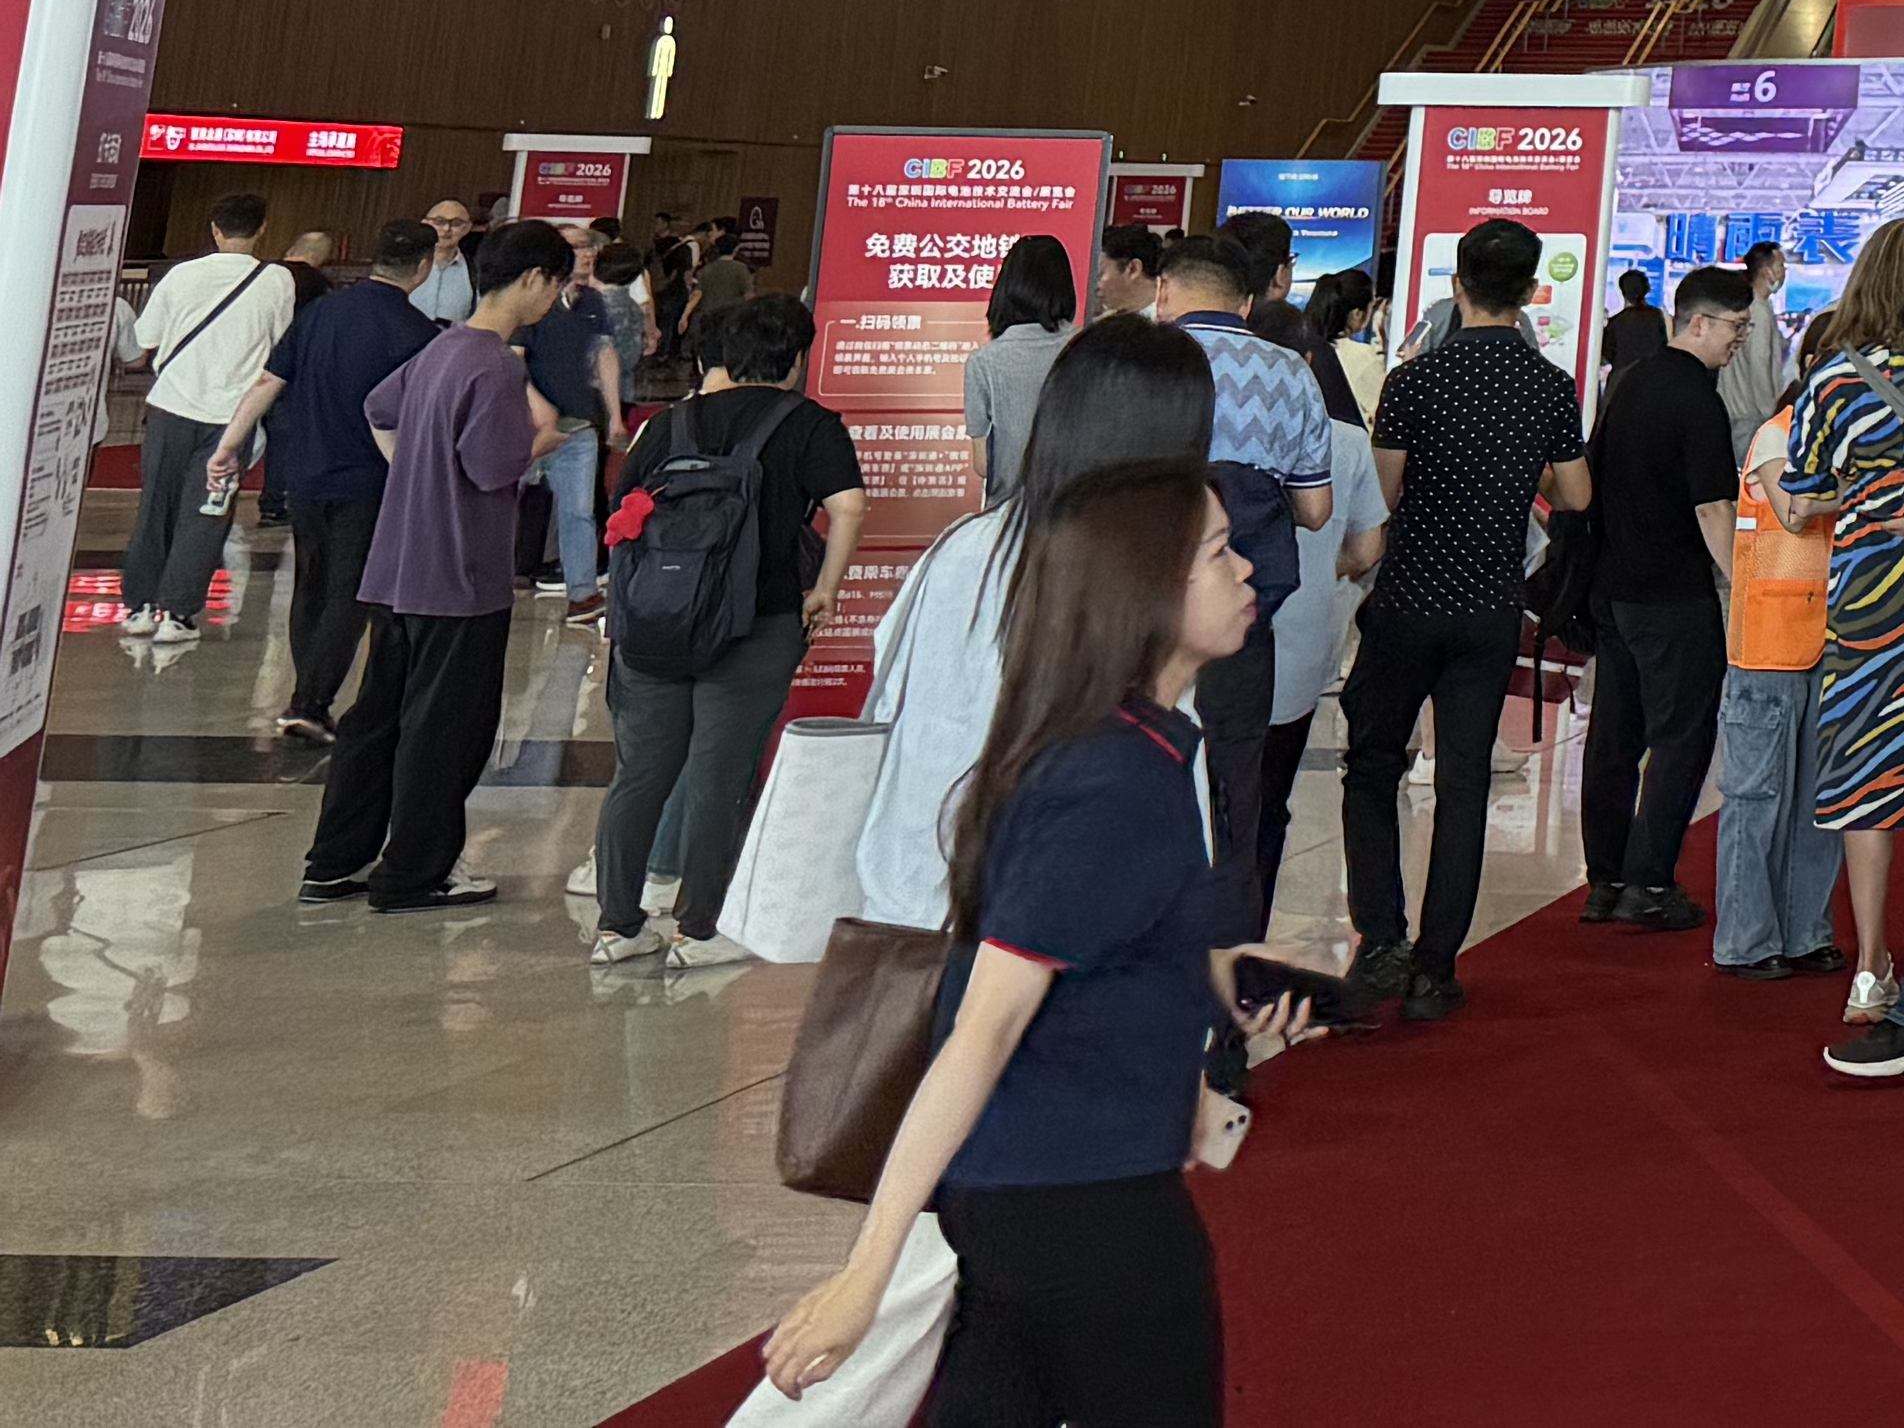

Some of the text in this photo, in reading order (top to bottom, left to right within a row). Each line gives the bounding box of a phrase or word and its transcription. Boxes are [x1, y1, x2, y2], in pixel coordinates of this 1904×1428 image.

[1753, 70, 1777, 102] 6
[1447, 127, 1583, 151] CIBF 2026
[575, 163, 611, 176] 2026
[904, 158, 1025, 180] CIBF 2026
[847, 197, 868, 208] The
[896, 197, 928, 208] China
[931, 197, 1005, 209] International
[1007, 198, 1049, 211] Battery
[1052, 198, 1074, 209] Fair
[1285, 206, 1315, 218] OUR
[1318, 206, 1369, 219] WORLD
[888, 264, 1001, 290] 获取及使
